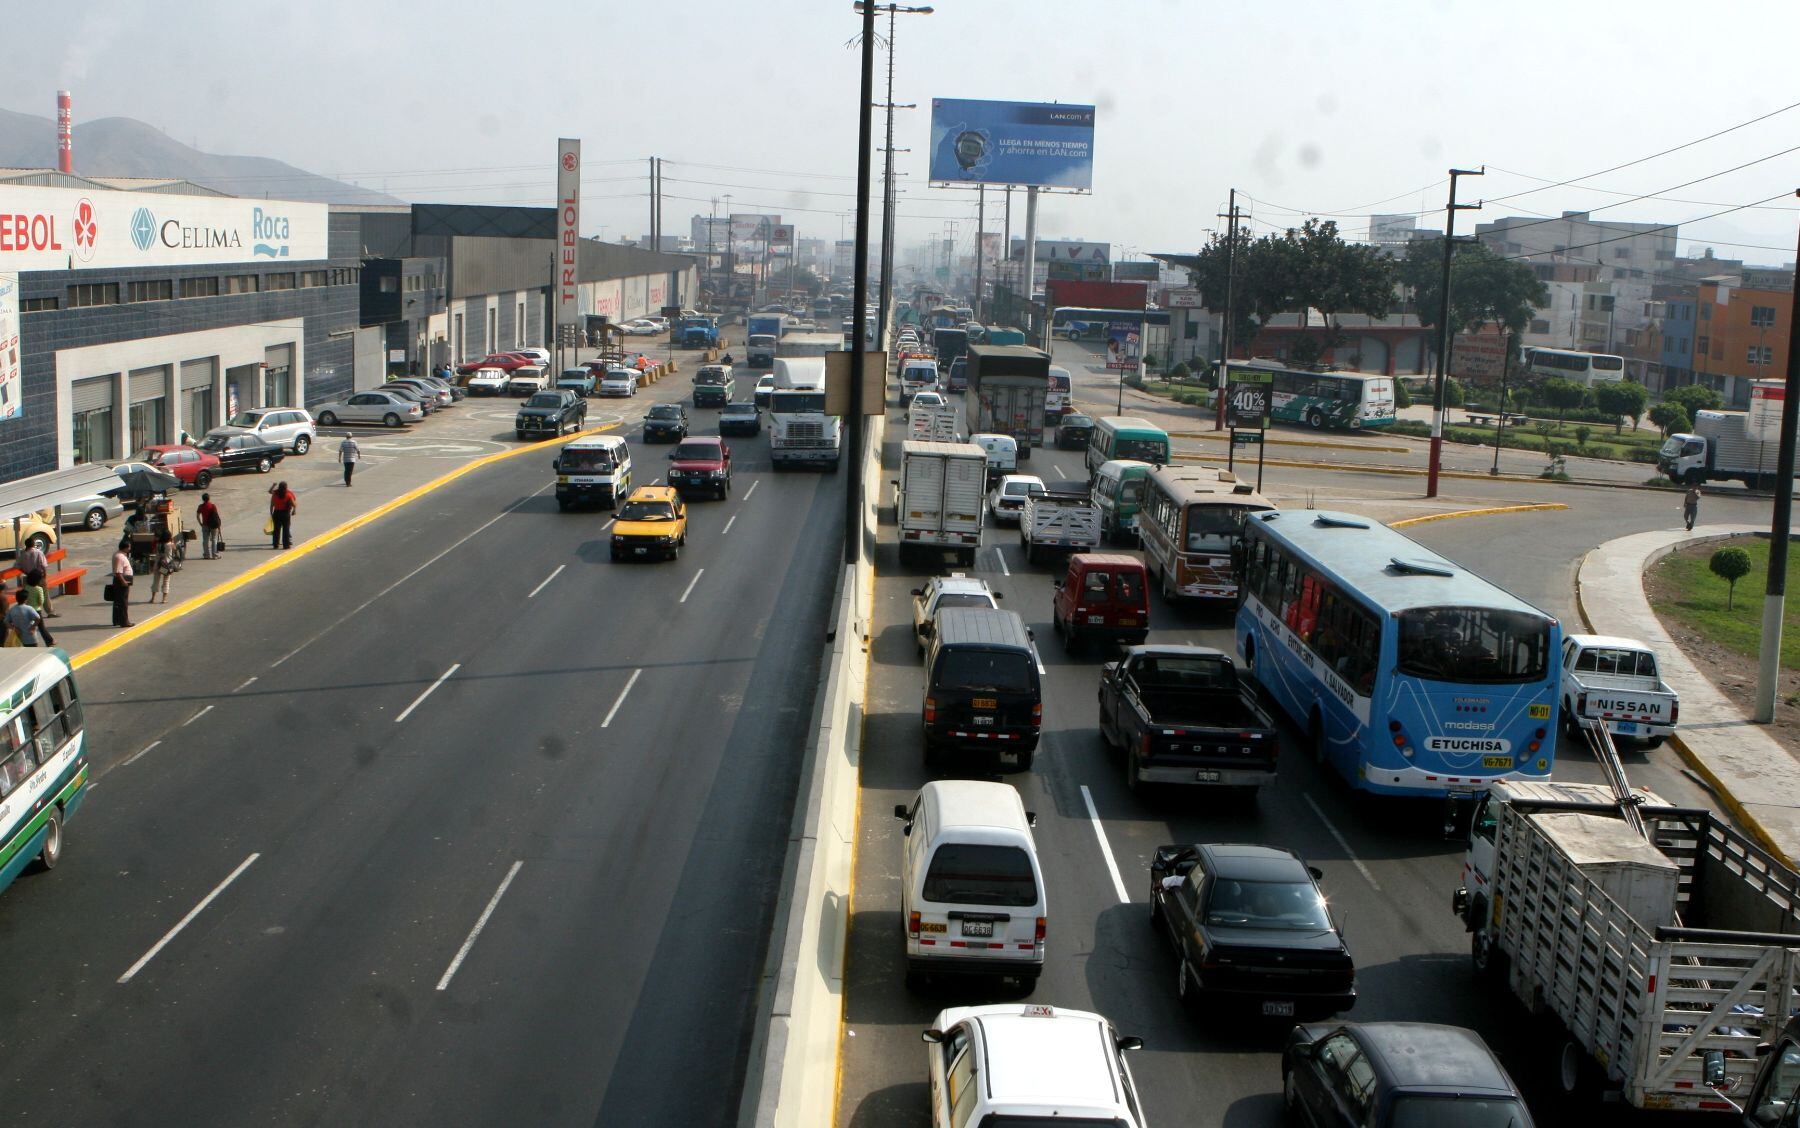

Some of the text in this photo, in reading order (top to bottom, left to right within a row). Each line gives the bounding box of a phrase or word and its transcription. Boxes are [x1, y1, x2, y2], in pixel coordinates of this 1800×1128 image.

[1000, 147, 1005, 155] y
[1049, 148, 1087, 157] LAN.com
[254, 207, 289, 239] Roca
[563, 189, 576, 305] TREBOL
[1233, 391, 1265, 410] 40%
[1597, 699, 1661, 714] NISSAN
[1444, 721, 1496, 731] modasa
[1170, 744, 1251, 754] FORD
[1432, 739, 1503, 751] ETUCHISA
